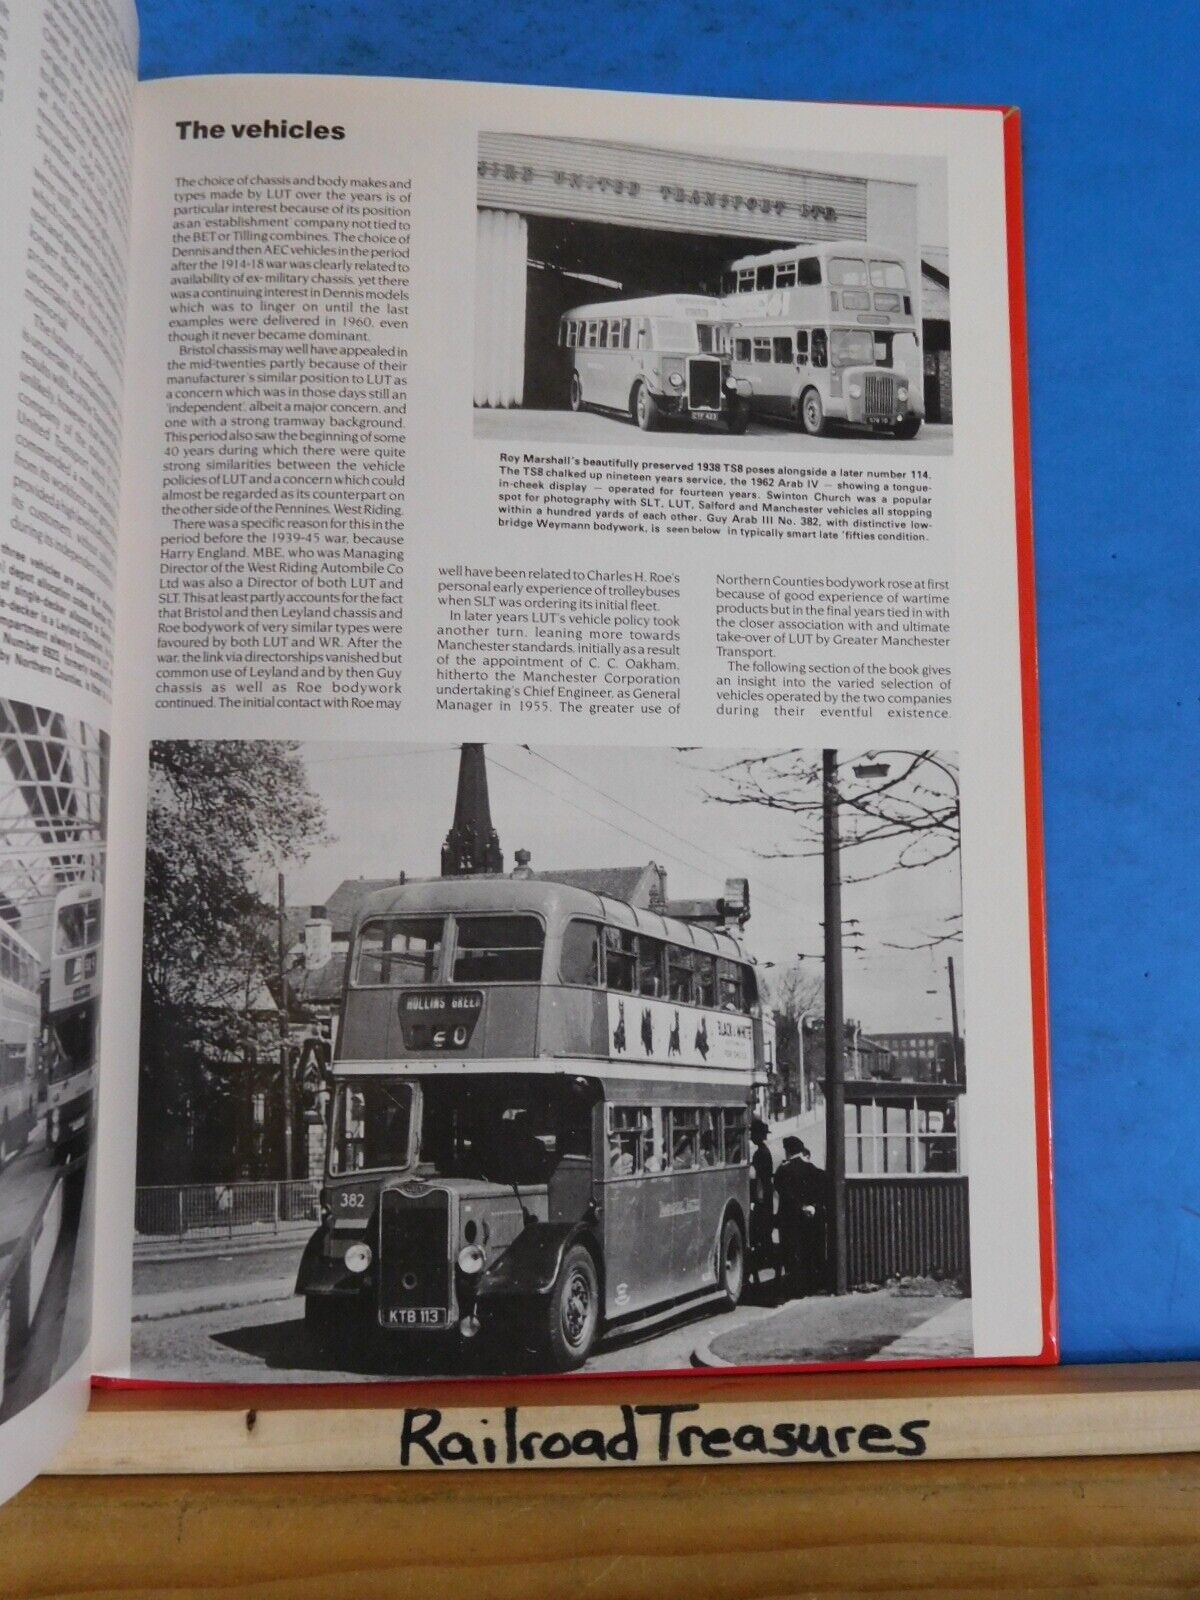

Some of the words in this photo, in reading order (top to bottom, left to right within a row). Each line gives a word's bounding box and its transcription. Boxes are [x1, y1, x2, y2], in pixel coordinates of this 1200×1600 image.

[175, 121, 226, 140] The
[231, 119, 346, 141] vehicles
[660, 185, 787, 216] TRANSPORT
[169, 301, 205, 313] which
[211, 303, 234, 312] was
[240, 302, 253, 311] to
[259, 299, 295, 313] linger
[301, 303, 318, 312] on
[324, 300, 354, 312] until
[359, 301, 380, 313] the
[386, 302, 409, 315] last
[162, 461, 201, 473] strong
[205, 458, 272, 470] similarities
[276, 458, 331, 470] between
[336, 459, 357, 470] the
[361, 459, 405, 472] vehicle
[499, 452, 520, 464] Roy
[522, 453, 580, 465] Marshall's
[582, 457, 639, 469] beautifully
[641, 460, 694, 471] preserved
[697, 462, 721, 472] 1938
[723, 463, 744, 473] TS8
[745, 466, 775, 475] poses
[777, 465, 828, 478] alongside
[830, 469, 837, 477] a
[839, 468, 863, 477] later
[866, 469, 906, 479] number
[911, 470, 932, 479] 114.
[498, 492, 522, 502] spot
[524, 492, 540, 502] for
[542, 493, 611, 507] photography
[613, 496, 637, 506] with
[697, 499, 736, 510] Salford
[738, 501, 759, 511] and
[761, 502, 823, 514] Manchester
[826, 505, 869, 515] vehicles
[870, 506, 885, 515] all
[886, 507, 932, 518] stopping
[498, 504, 532, 514] within
[535, 507, 543, 515] a
[545, 505, 592, 517] hundred
[594, 508, 625, 520] yards
[627, 509, 639, 519] of
[642, 510, 667, 520] each
[670, 511, 701, 522] other.
[706, 512, 728, 524] Guy
[731, 513, 758, 524] Arab
[761, 515, 774, 524] III
[825, 517, 849, 527] with
[852, 518, 907, 529] distinctive
[910, 520, 932, 529] low-
[497, 516, 533, 529] bridge
[535, 518, 591, 530] Weymann
[592, 521, 648, 533] bodywork,
[650, 523, 660, 533] is
[691, 525, 721, 535] below
[726, 525, 738, 535] in
[739, 527, 784, 539] typically
[786, 530, 817, 538] smart
[818, 529, 839, 539] late
[877, 531, 929, 541] condition.
[715, 573, 771, 586] Northern
[772, 575, 825, 587] Counties
[824, 576, 886, 590] bodywork
[886, 580, 913, 589] rose
[913, 580, 925, 589] at
[926, 578, 949, 589] first
[449, 609, 462, 620] In
[463, 609, 493, 621] later
[495, 613, 529, 624] years
[531, 611, 566, 623] LUT's
[568, 611, 611, 625] vehicle
[613, 613, 650, 628] policy
[652, 614, 680, 626] took
[715, 615, 736, 628] the
[738, 616, 775, 629] closer
[777, 618, 844, 630] association
[847, 619, 873, 631] with
[876, 620, 899, 631] and
[902, 620, 950, 632] ultimate
[436, 623, 489, 636] another
[534, 626, 583, 640] leaning
[588, 630, 623, 639] more
[629, 628, 680, 641] towards
[716, 630, 772, 643] take-over
[773, 631, 786, 643] of
[788, 632, 813, 644] LUT
[815, 632, 831, 646] by
[832, 633, 878, 645] Greater
[880, 634, 950, 646] Manchester
[715, 645, 776, 658] Transport.
[15, 653, 53, 675] Northern
[436, 668, 489, 680] hitherto
[494, 669, 516, 680] the
[522, 670, 597, 682] Manchester
[603, 672, 680, 686] Corporation
[155, 681, 202, 693] chassis
[211, 683, 226, 693] as
[235, 680, 263, 692] well
[271, 683, 287, 692] as
[296, 681, 322, 692] Roe
[331, 681, 402, 695] bodywork
[435, 683, 520, 698] undertaking's
[522, 684, 555, 697] Chief
[616, 689, 631, 698] as
[632, 687, 681, 699] General
[716, 688, 765, 701] vehicles
[765, 689, 822, 703] operated
[823, 690, 838, 704] by
[840, 691, 861, 703] the
[862, 693, 885, 703] two
[887, 694, 952, 705] companies
[436, 698, 492, 712] Manager
[499, 700, 511, 710] in
[519, 700, 551, 711] 1955.
[559, 700, 583, 712] The
[588, 703, 634, 716] greater
[640, 704, 662, 714] use
[667, 702, 680, 714] of
[715, 703, 759, 717] during
[773, 704, 805, 716] their
[819, 705, 873, 717] eventful
[887, 708, 951, 718] existence.
[340, 1193, 365, 1208] 382
[389, 1310, 417, 1323] KTB
[420, 1309, 439, 1323] 113
